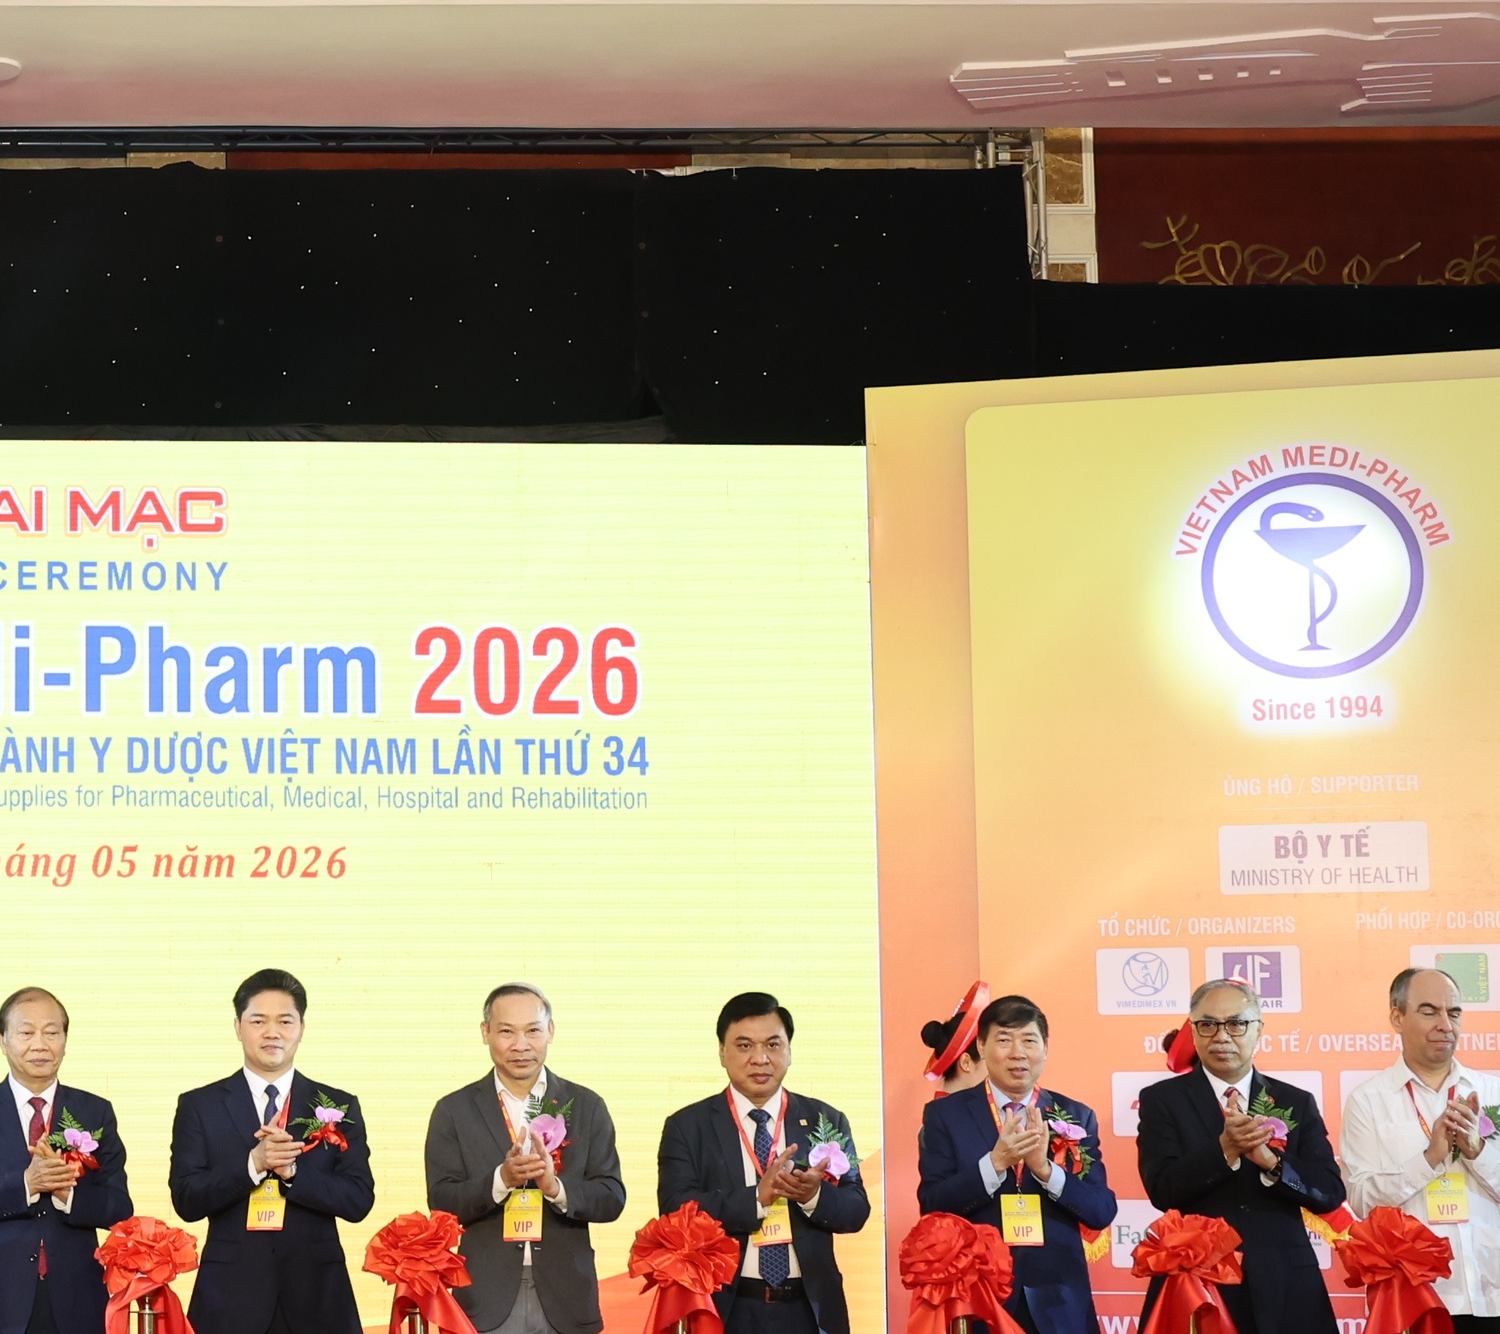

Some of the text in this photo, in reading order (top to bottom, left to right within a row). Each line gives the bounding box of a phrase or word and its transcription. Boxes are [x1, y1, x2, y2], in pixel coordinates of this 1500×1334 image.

[1175, 444, 1451, 557] VIETNAM MEDI-PHARM
[68, 488, 226, 548] MẠC
[413, 625, 639, 716] 2026
[1252, 695, 1384, 722] Since 1994
[89, 735, 114, 774] Y
[127, 731, 229, 783] DƯỢC
[241, 727, 322, 784] VIỆT
[334, 737, 417, 775] NAM
[431, 724, 502, 776] LẦN
[515, 729, 591, 777] THỨ
[602, 735, 650, 777] 34
[1310, 774, 1420, 795] SUPPORTER
[75, 783, 101, 809] for
[111, 784, 275, 812] Pharmaceutical,
[283, 785, 368, 813] Medical,
[377, 786, 459, 814] Hospital
[467, 787, 503, 810] and
[511, 786, 649, 811] Rehabilitation
[1273, 825, 1371, 865] BỘ Y TẾ
[91, 844, 139, 879] 05
[152, 844, 236, 879] năm
[250, 845, 347, 880] 2026
[1230, 865, 1419, 888] MINISTRY OF HEALTH
[1097, 911, 1120, 938] TỔ
[1124, 913, 1172, 938] CHỨC
[1186, 915, 1297, 937] ORGANIZERS
[1355, 908, 1394, 931] PHỐI
[1115, 999, 1178, 1009] VIMEDIMEX VN
[1276, 1029, 1302, 1053] TẾ
[1317, 1033, 1402, 1053] OVERSEA
[256, 1210, 276, 1223] VIP
[1437, 1203, 1458, 1216] VIP
[513, 1220, 533, 1233] VIP
[761, 1224, 781, 1237] VIP
[1012, 1225, 1033, 1238] VIP
